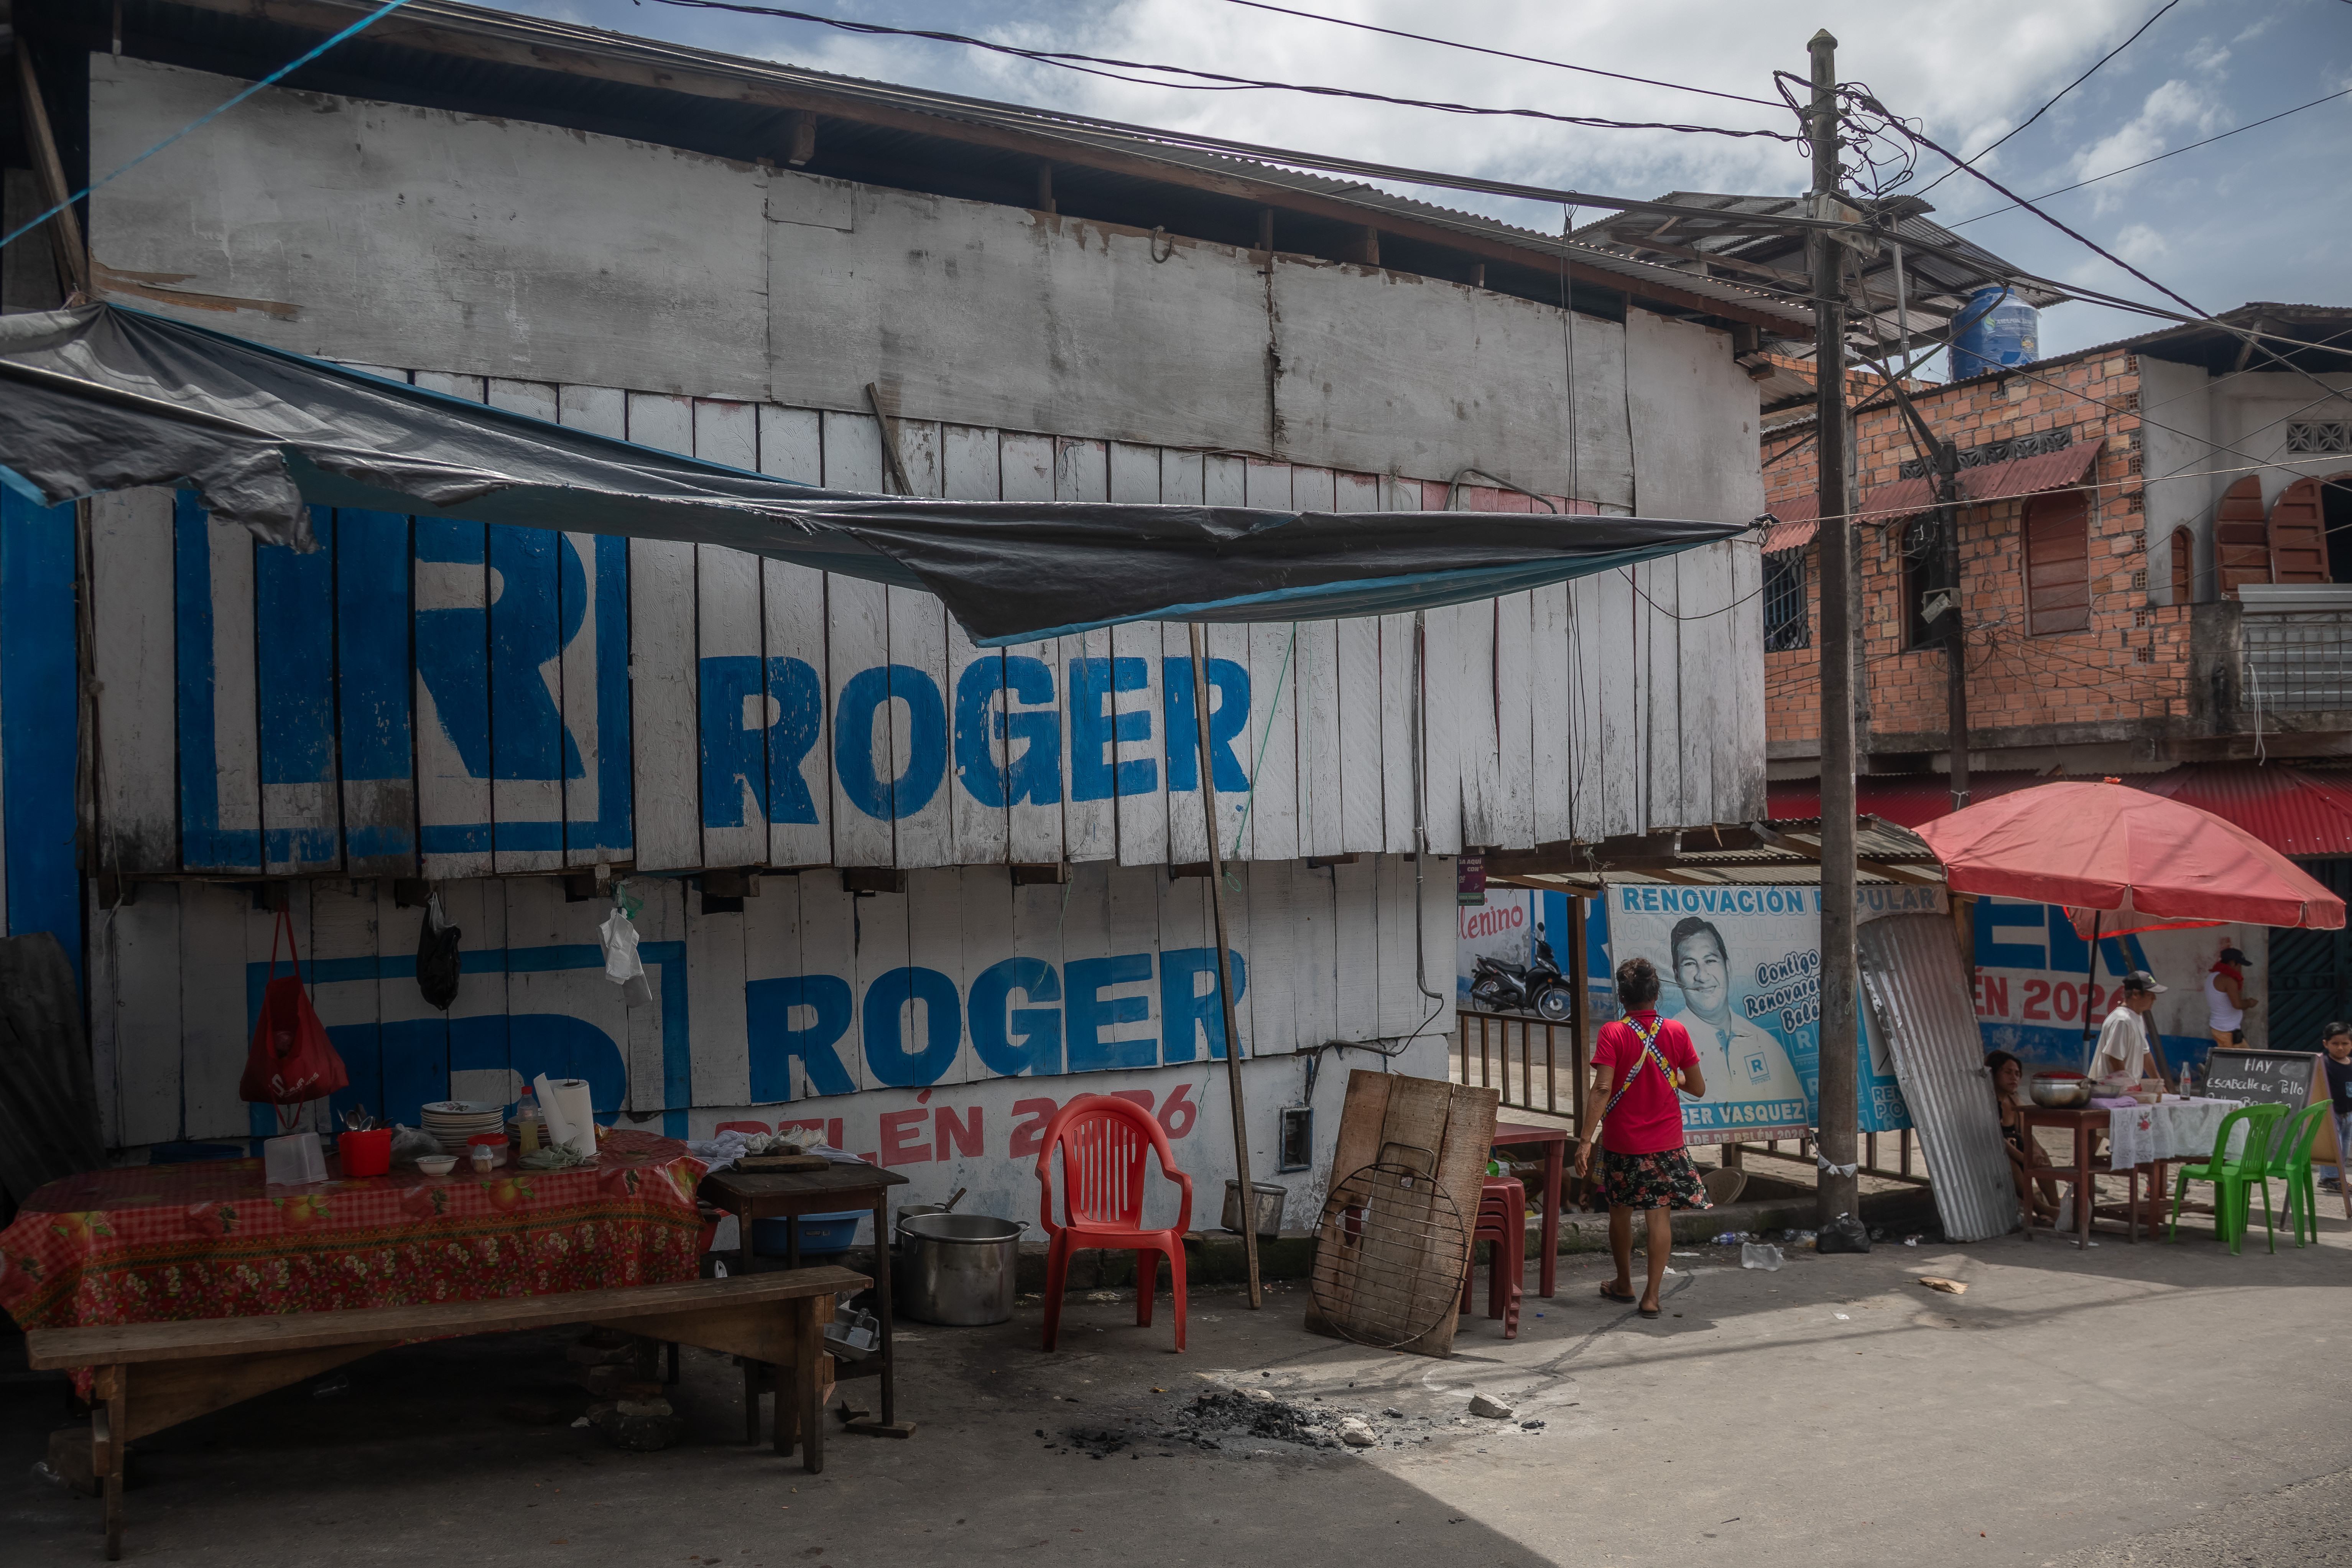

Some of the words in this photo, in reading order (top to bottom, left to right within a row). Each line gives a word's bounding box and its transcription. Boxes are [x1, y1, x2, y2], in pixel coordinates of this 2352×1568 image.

[700, 655, 1251, 828] ROGER
[1622, 885, 1804, 912] RENOVACIÓN
[1458, 905, 1523, 939] lenino
[1758, 952, 1818, 985] Contigo
[1745, 977, 1820, 1017] Renovare
[746, 948, 1247, 1104] ROGER
[1783, 999, 1820, 1031] Belé
[1795, 1030, 1813, 1049] R
[1751, 1059, 1763, 1073] R
[2244, 1058, 2273, 1074] HAY
[2261, 1083, 2273, 1092] DE
[2278, 1079, 2304, 1095] Pollo
[1009, 1083, 1197, 1158] 26
[1681, 1107, 1714, 1125] GER
[1718, 1102, 1804, 1124] VASQUEZ
[1713, 1132, 1730, 1144] DE
[1734, 1129, 1773, 1142] BELÉN
